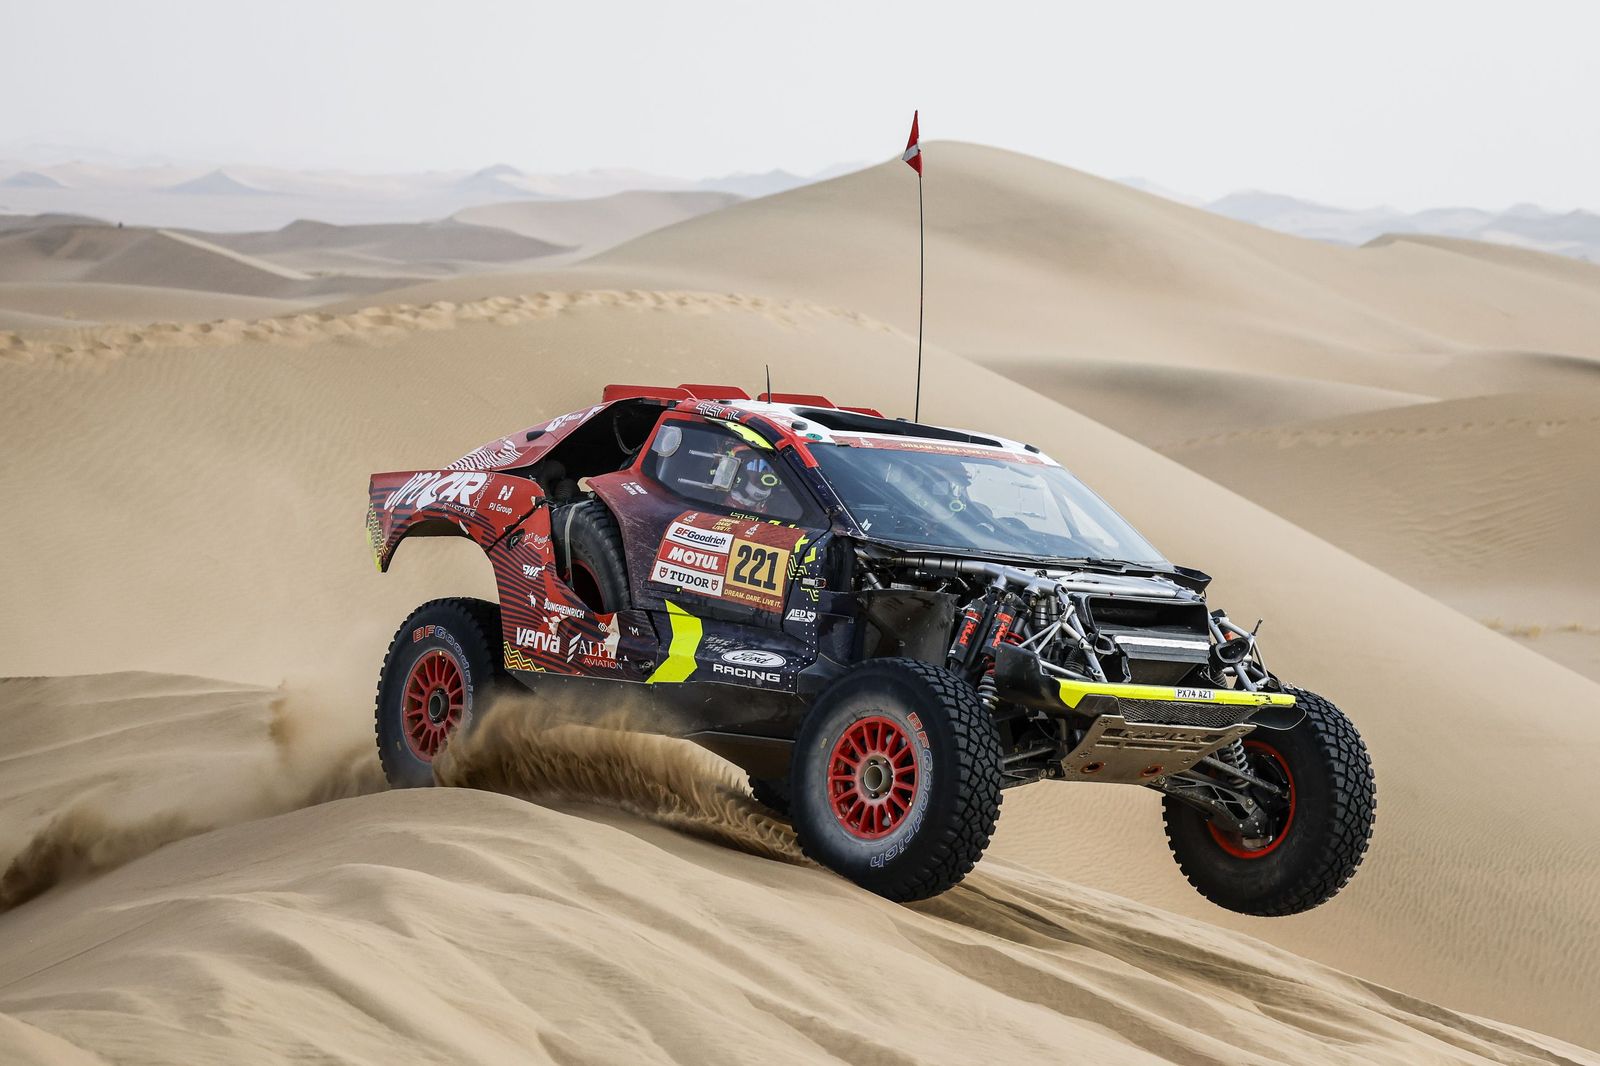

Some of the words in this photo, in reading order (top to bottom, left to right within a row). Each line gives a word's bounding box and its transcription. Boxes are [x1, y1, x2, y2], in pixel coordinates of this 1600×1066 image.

[496, 504, 513, 515] Group
[674, 526, 727, 545] BFGoodrich
[667, 546, 719, 570] MOTUL
[732, 544, 780, 591] 221
[670, 570, 709, 589] TUDOR
[723, 588, 746, 599] DREAM.
[745, 593, 762, 603] DARE.
[762, 597, 775, 606] LIVE
[516, 626, 561, 654] verva
[583, 657, 623, 670] AVIATION
[731, 651, 775, 664] Ford
[712, 663, 781, 683] RACING
[1177, 689, 1196, 698] PX74
[870, 711, 933, 868] BFGoodrich
